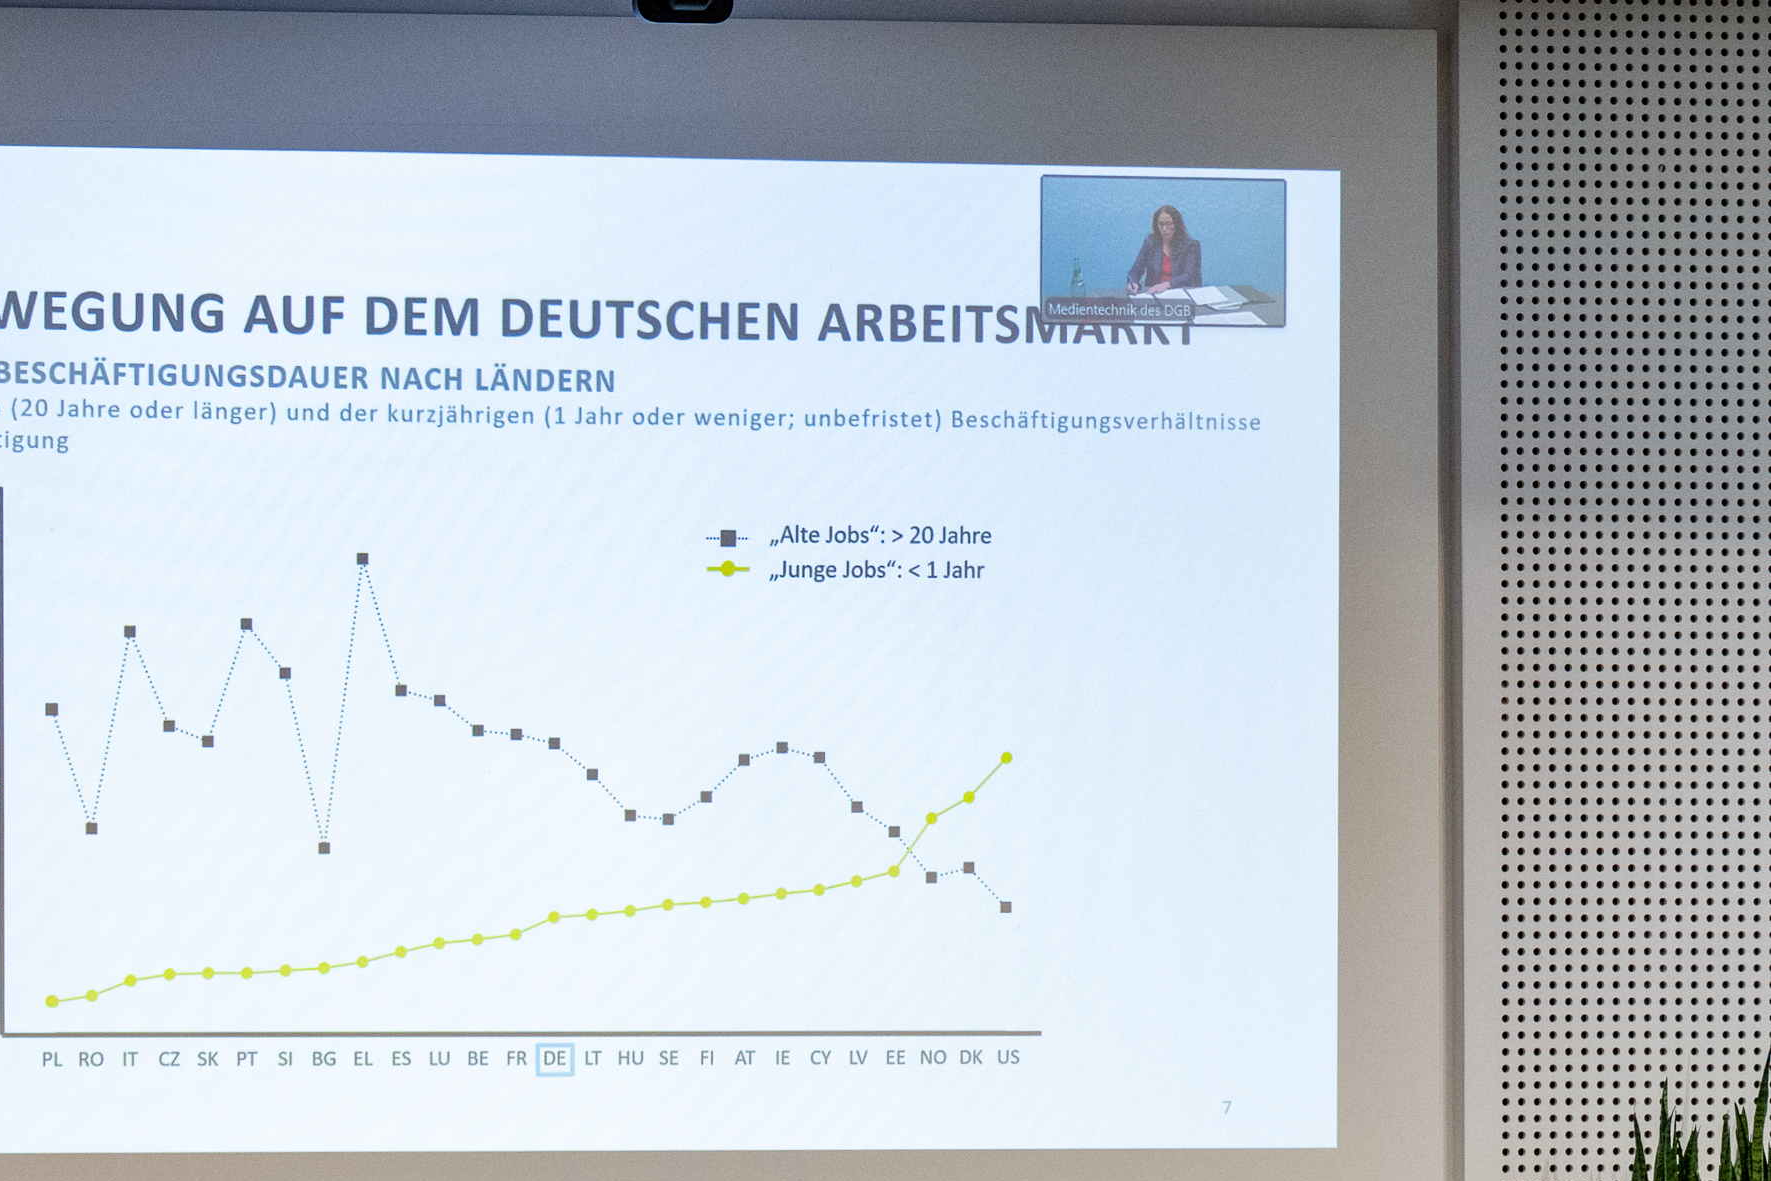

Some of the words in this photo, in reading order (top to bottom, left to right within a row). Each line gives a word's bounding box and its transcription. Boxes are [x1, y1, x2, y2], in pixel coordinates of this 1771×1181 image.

[243, 294, 345, 336] AUF
[365, 296, 479, 337] DEM
[501, 298, 799, 342] DEUTSCHEN
[1048, 303, 1137, 317] Medientechnik
[1140, 303, 1161, 317] des
[1164, 304, 1192, 318] DGB
[380, 366, 463, 391] NACH
[475, 362, 615, 393] LÄNDERN
[10, 396, 49, 421] (20
[56, 397, 121, 419] Jahre
[129, 398, 184, 420] oder
[193, 400, 277, 426] länger)
[286, 402, 330, 422] und
[339, 402, 379, 423] der
[387, 403, 534, 429] kurzjährigen
[544, 405, 566, 430] (1
[574, 405, 624, 426] Jahr
[631, 406, 686, 427] oder
[693, 408, 794, 432] weniger;
[804, 407, 942, 433] unbefristet)
[951, 409, 1261, 435] Beschäftigungsverhältnisse
[909, 525, 935, 545] 20
[938, 525, 992, 545] Jahre
[927, 560, 938, 579] 1
[942, 559, 986, 579] Jahr
[42, 1051, 63, 1068] PL
[78, 1051, 105, 1068] RO
[122, 1051, 139, 1067] IT
[158, 1051, 181, 1068] CZ
[197, 1051, 219, 1067] SK
[236, 1051, 258, 1067] PT
[278, 1050, 293, 1066] SI
[312, 1050, 337, 1066] BG
[353, 1050, 374, 1067] EL
[391, 1050, 412, 1066] ES
[429, 1050, 451, 1066] LU
[467, 1050, 489, 1066] BE
[506, 1050, 527, 1066] FR
[543, 1050, 567, 1066] DE
[584, 1050, 603, 1066] LT
[618, 1050, 644, 1066] HU
[659, 1050, 679, 1066] SE
[700, 1050, 714, 1066] FI
[734, 1050, 756, 1066] AT
[775, 1049, 790, 1066] IE
[809, 1049, 832, 1065] CY
[849, 1049, 869, 1065] LV
[886, 1049, 906, 1065] EE
[920, 1049, 947, 1065] NO
[959, 1049, 983, 1065] DK
[997, 1049, 1021, 1065] US
[1222, 1100, 1233, 1115] 7
